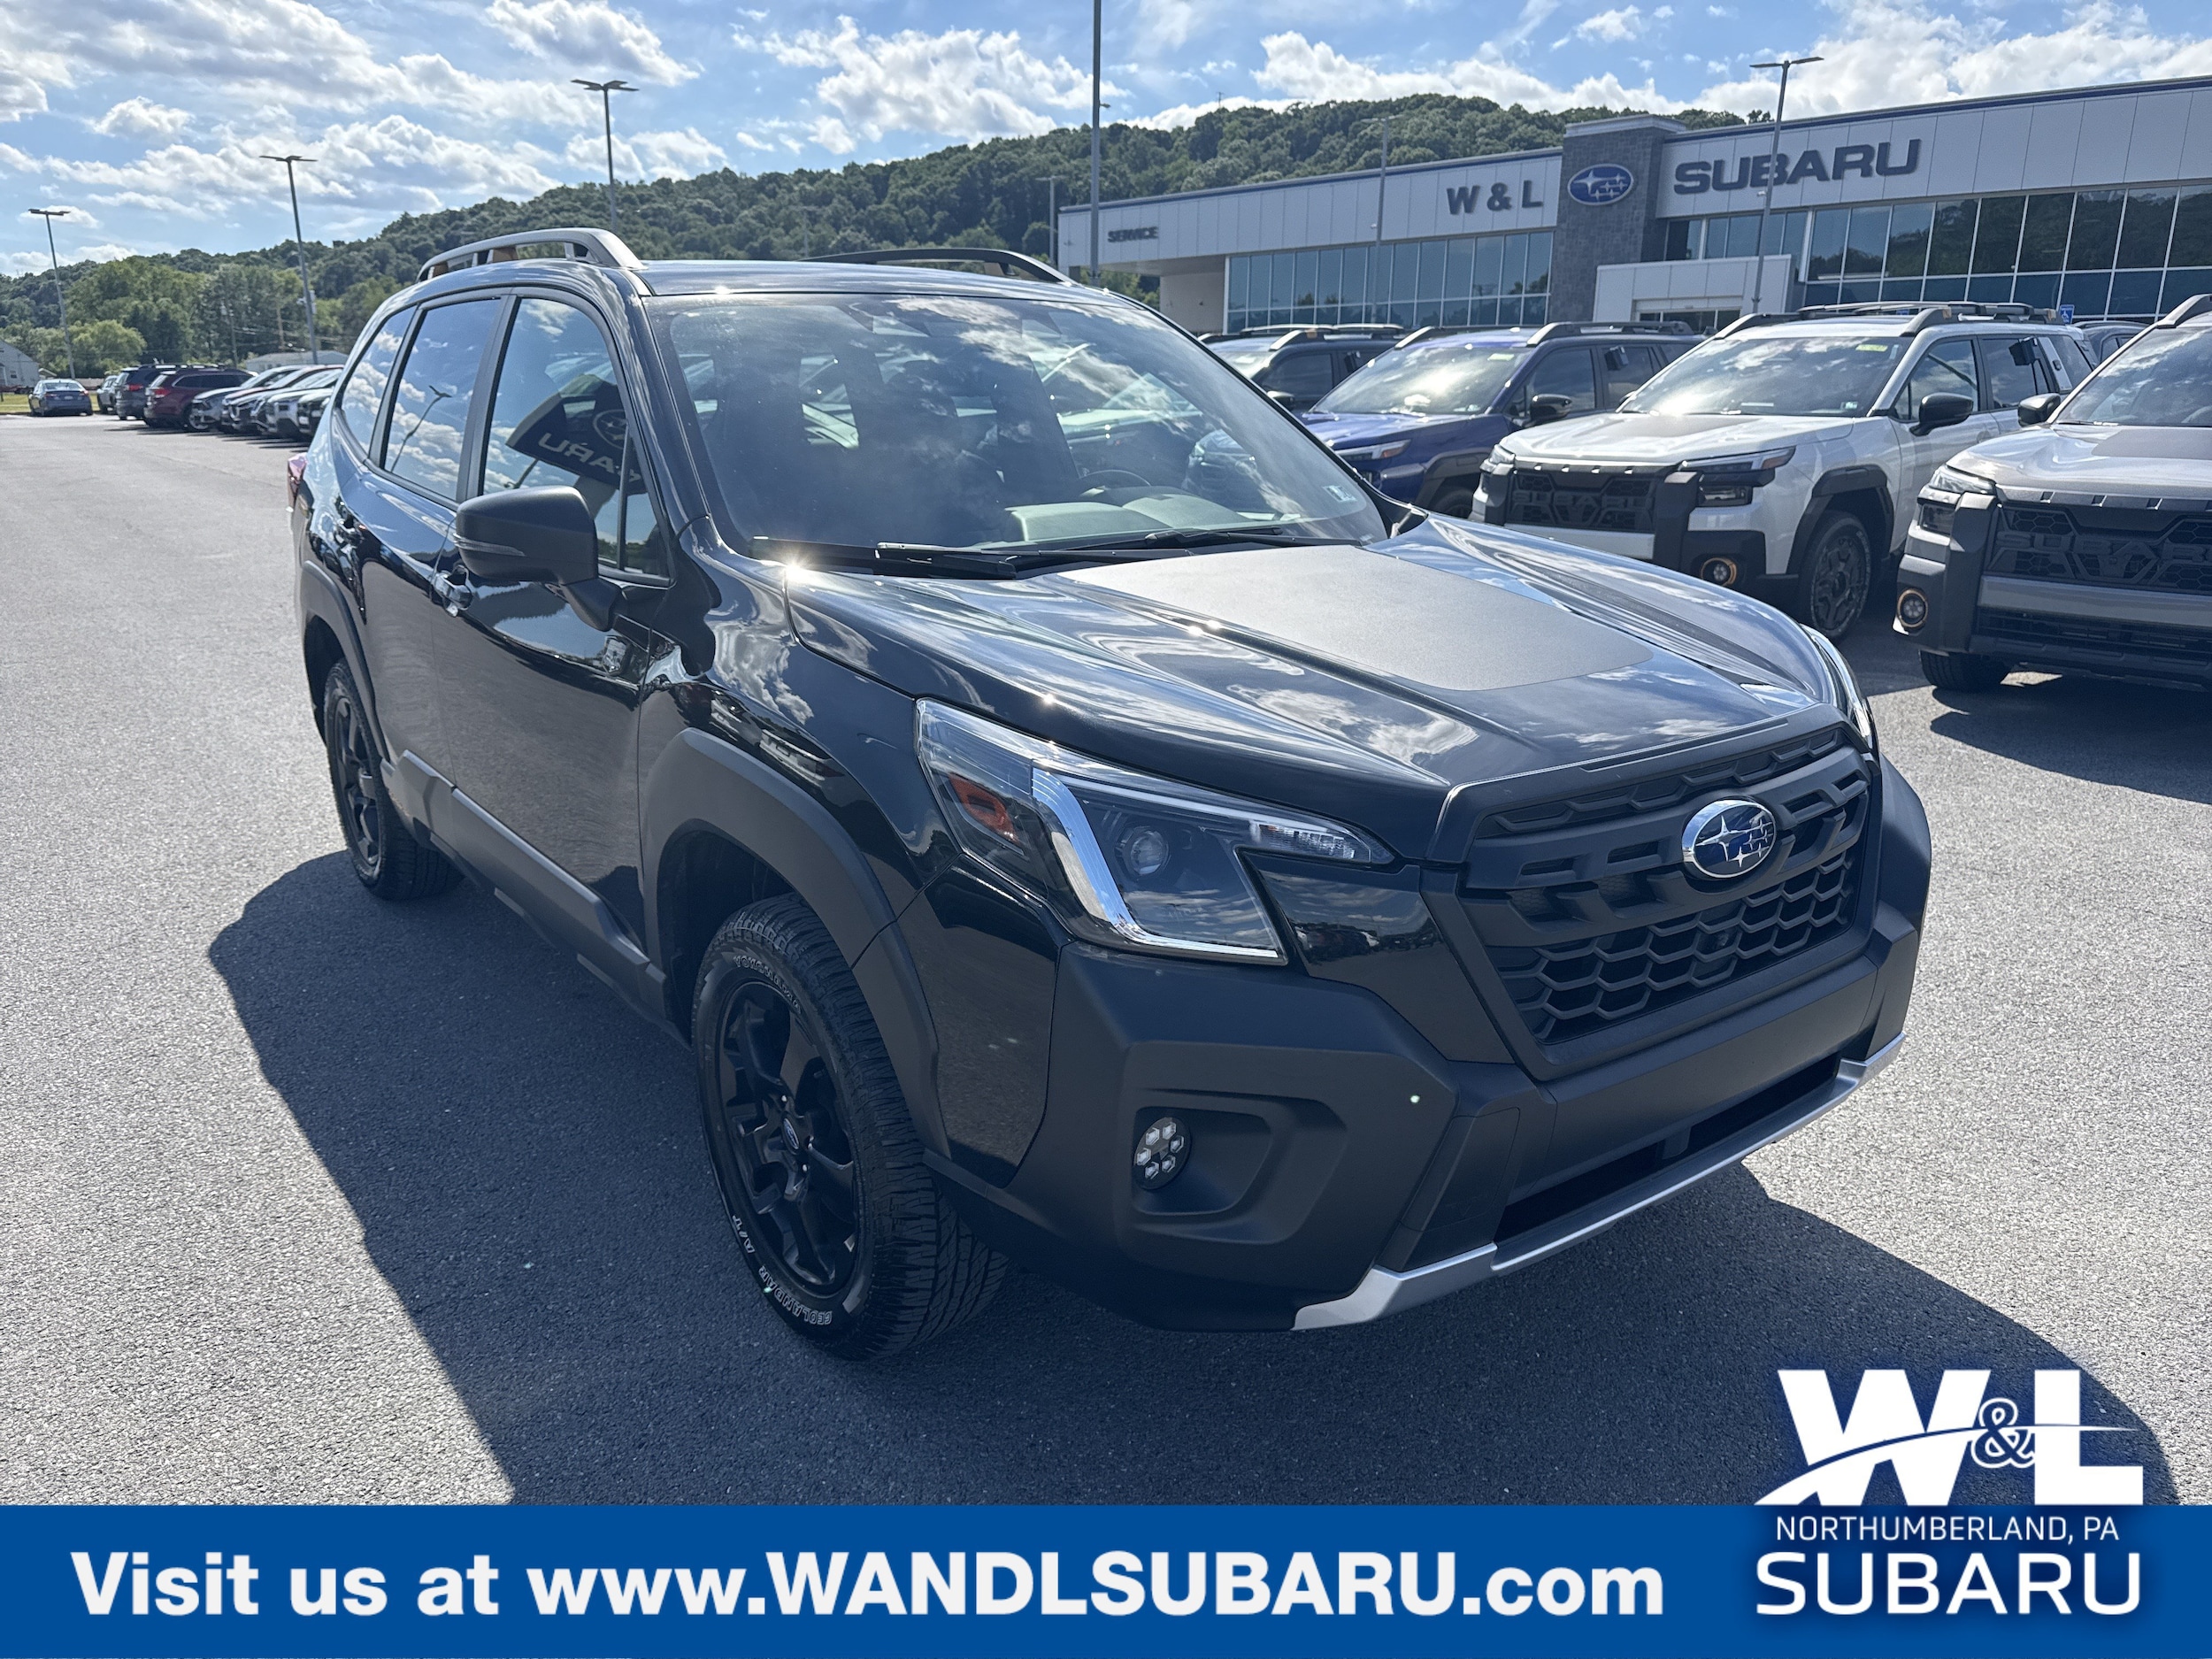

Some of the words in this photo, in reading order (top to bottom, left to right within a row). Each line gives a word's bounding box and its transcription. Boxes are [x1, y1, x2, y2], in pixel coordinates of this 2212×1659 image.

[1673, 138, 1923, 195] SUBARU
[1447, 185, 1481, 216] W
[1486, 181, 1513, 211] &
[1521, 180, 1544, 210] L
[1512, 488, 1655, 511] SUBARU
[1996, 530, 2212, 563] SUBAR
[733, 955, 802, 1015] YOKOHAMA
[732, 1215, 756, 1254] A/T
[757, 1265, 833, 1325] GEOLANDAR
